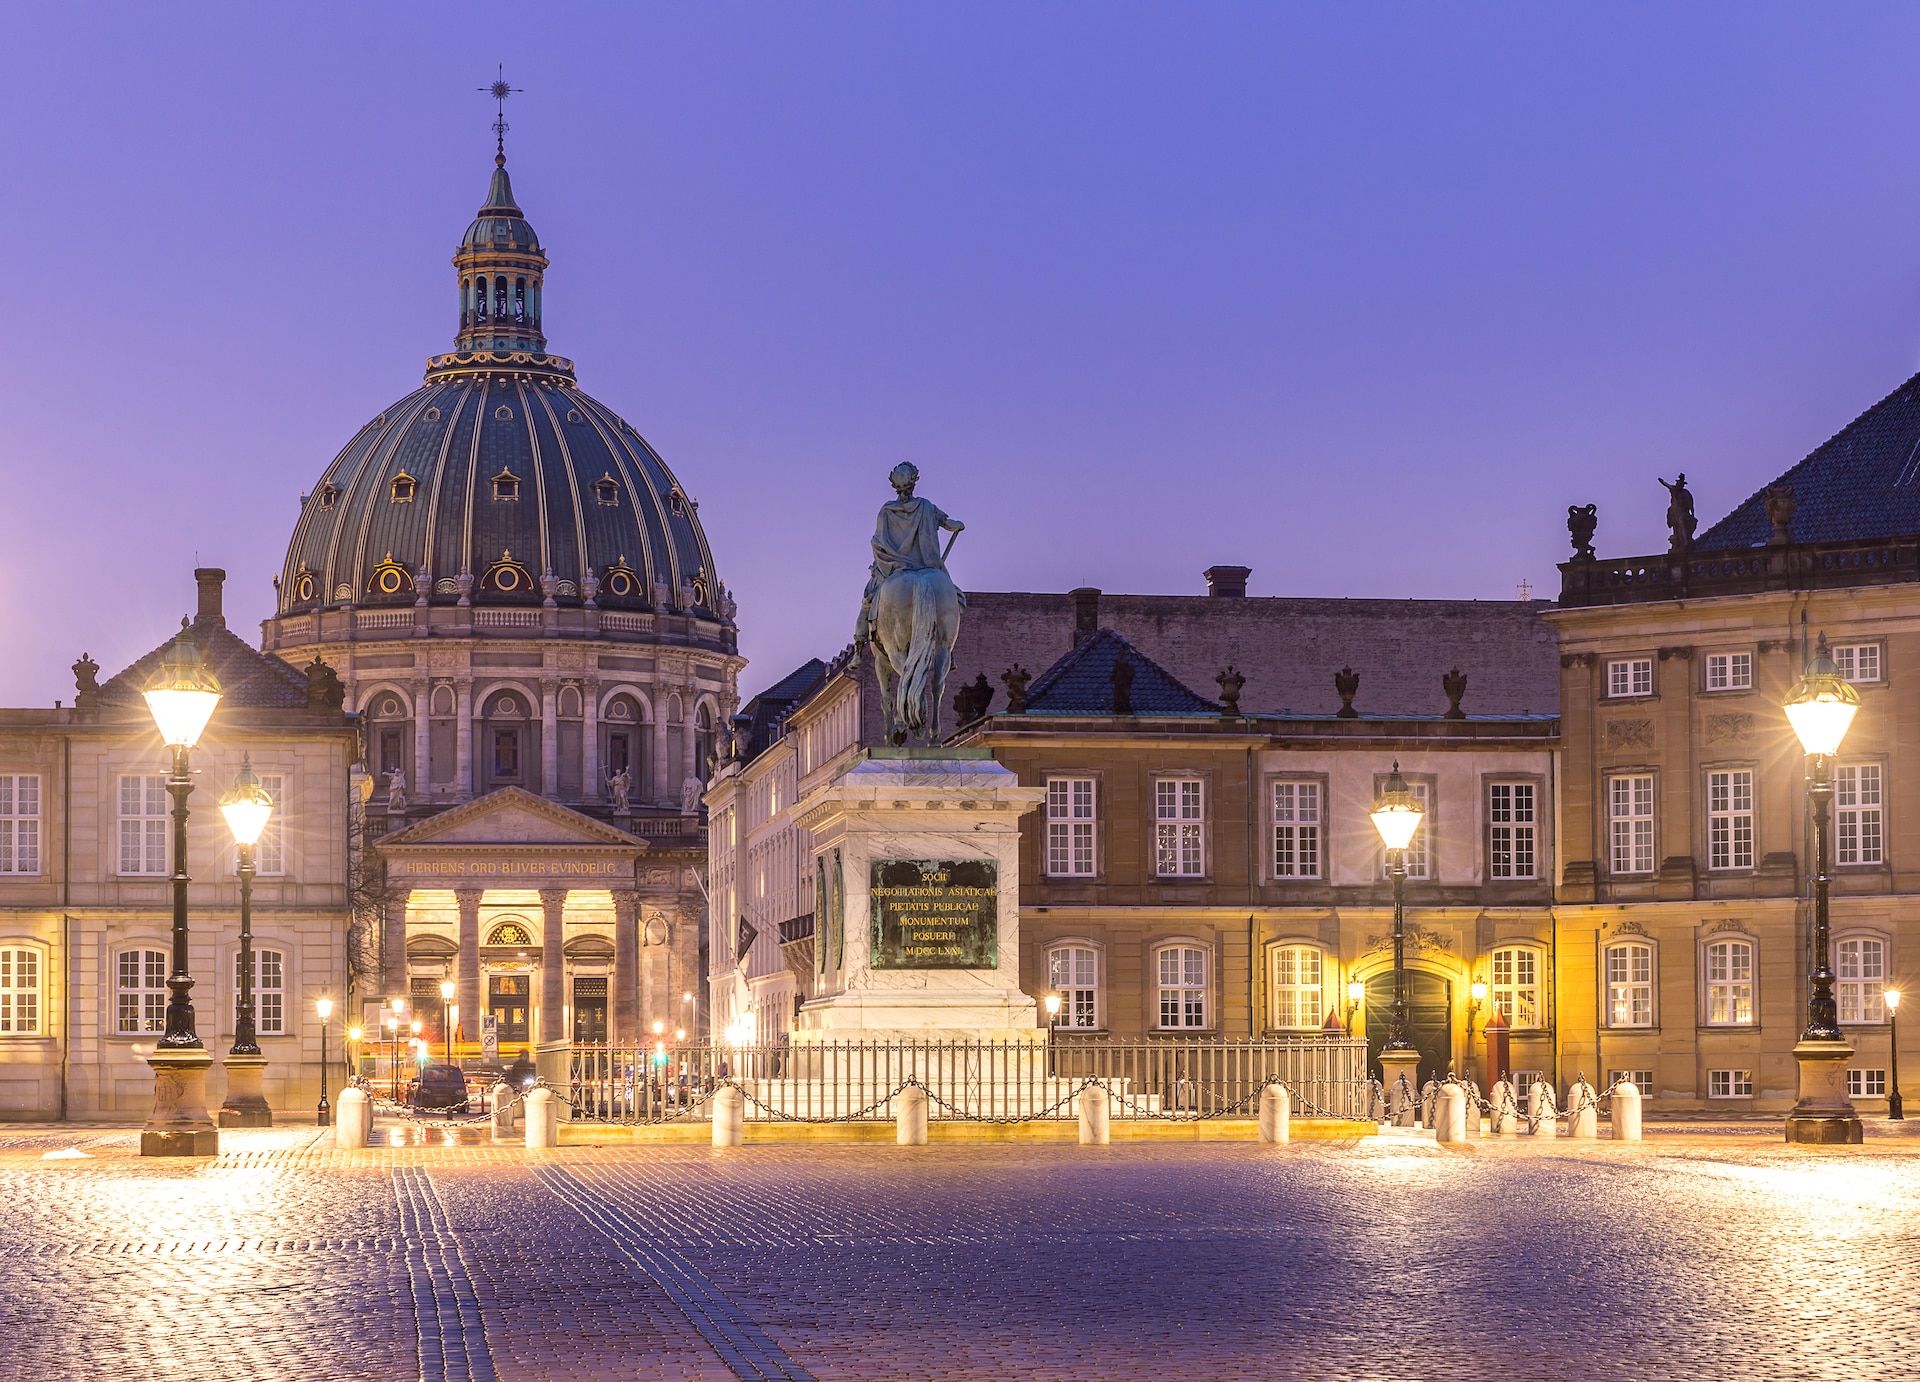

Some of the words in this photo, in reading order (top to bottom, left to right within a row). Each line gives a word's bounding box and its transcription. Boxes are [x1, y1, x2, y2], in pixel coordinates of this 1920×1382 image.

[407, 862, 465, 873] HERRENS
[470, 862, 497, 873] ORD
[502, 862, 546, 873] BLIVER
[551, 863, 616, 874] EVINDELIG
[921, 873, 947, 882] SOCII
[871, 887, 943, 896] NEGOTIATIONIS
[948, 887, 996, 896] ASIATICAE
[890, 902, 929, 911] PIETATIS
[934, 902, 979, 911] PUBLICAE
[900, 917, 969, 926] MONUMENTUM
